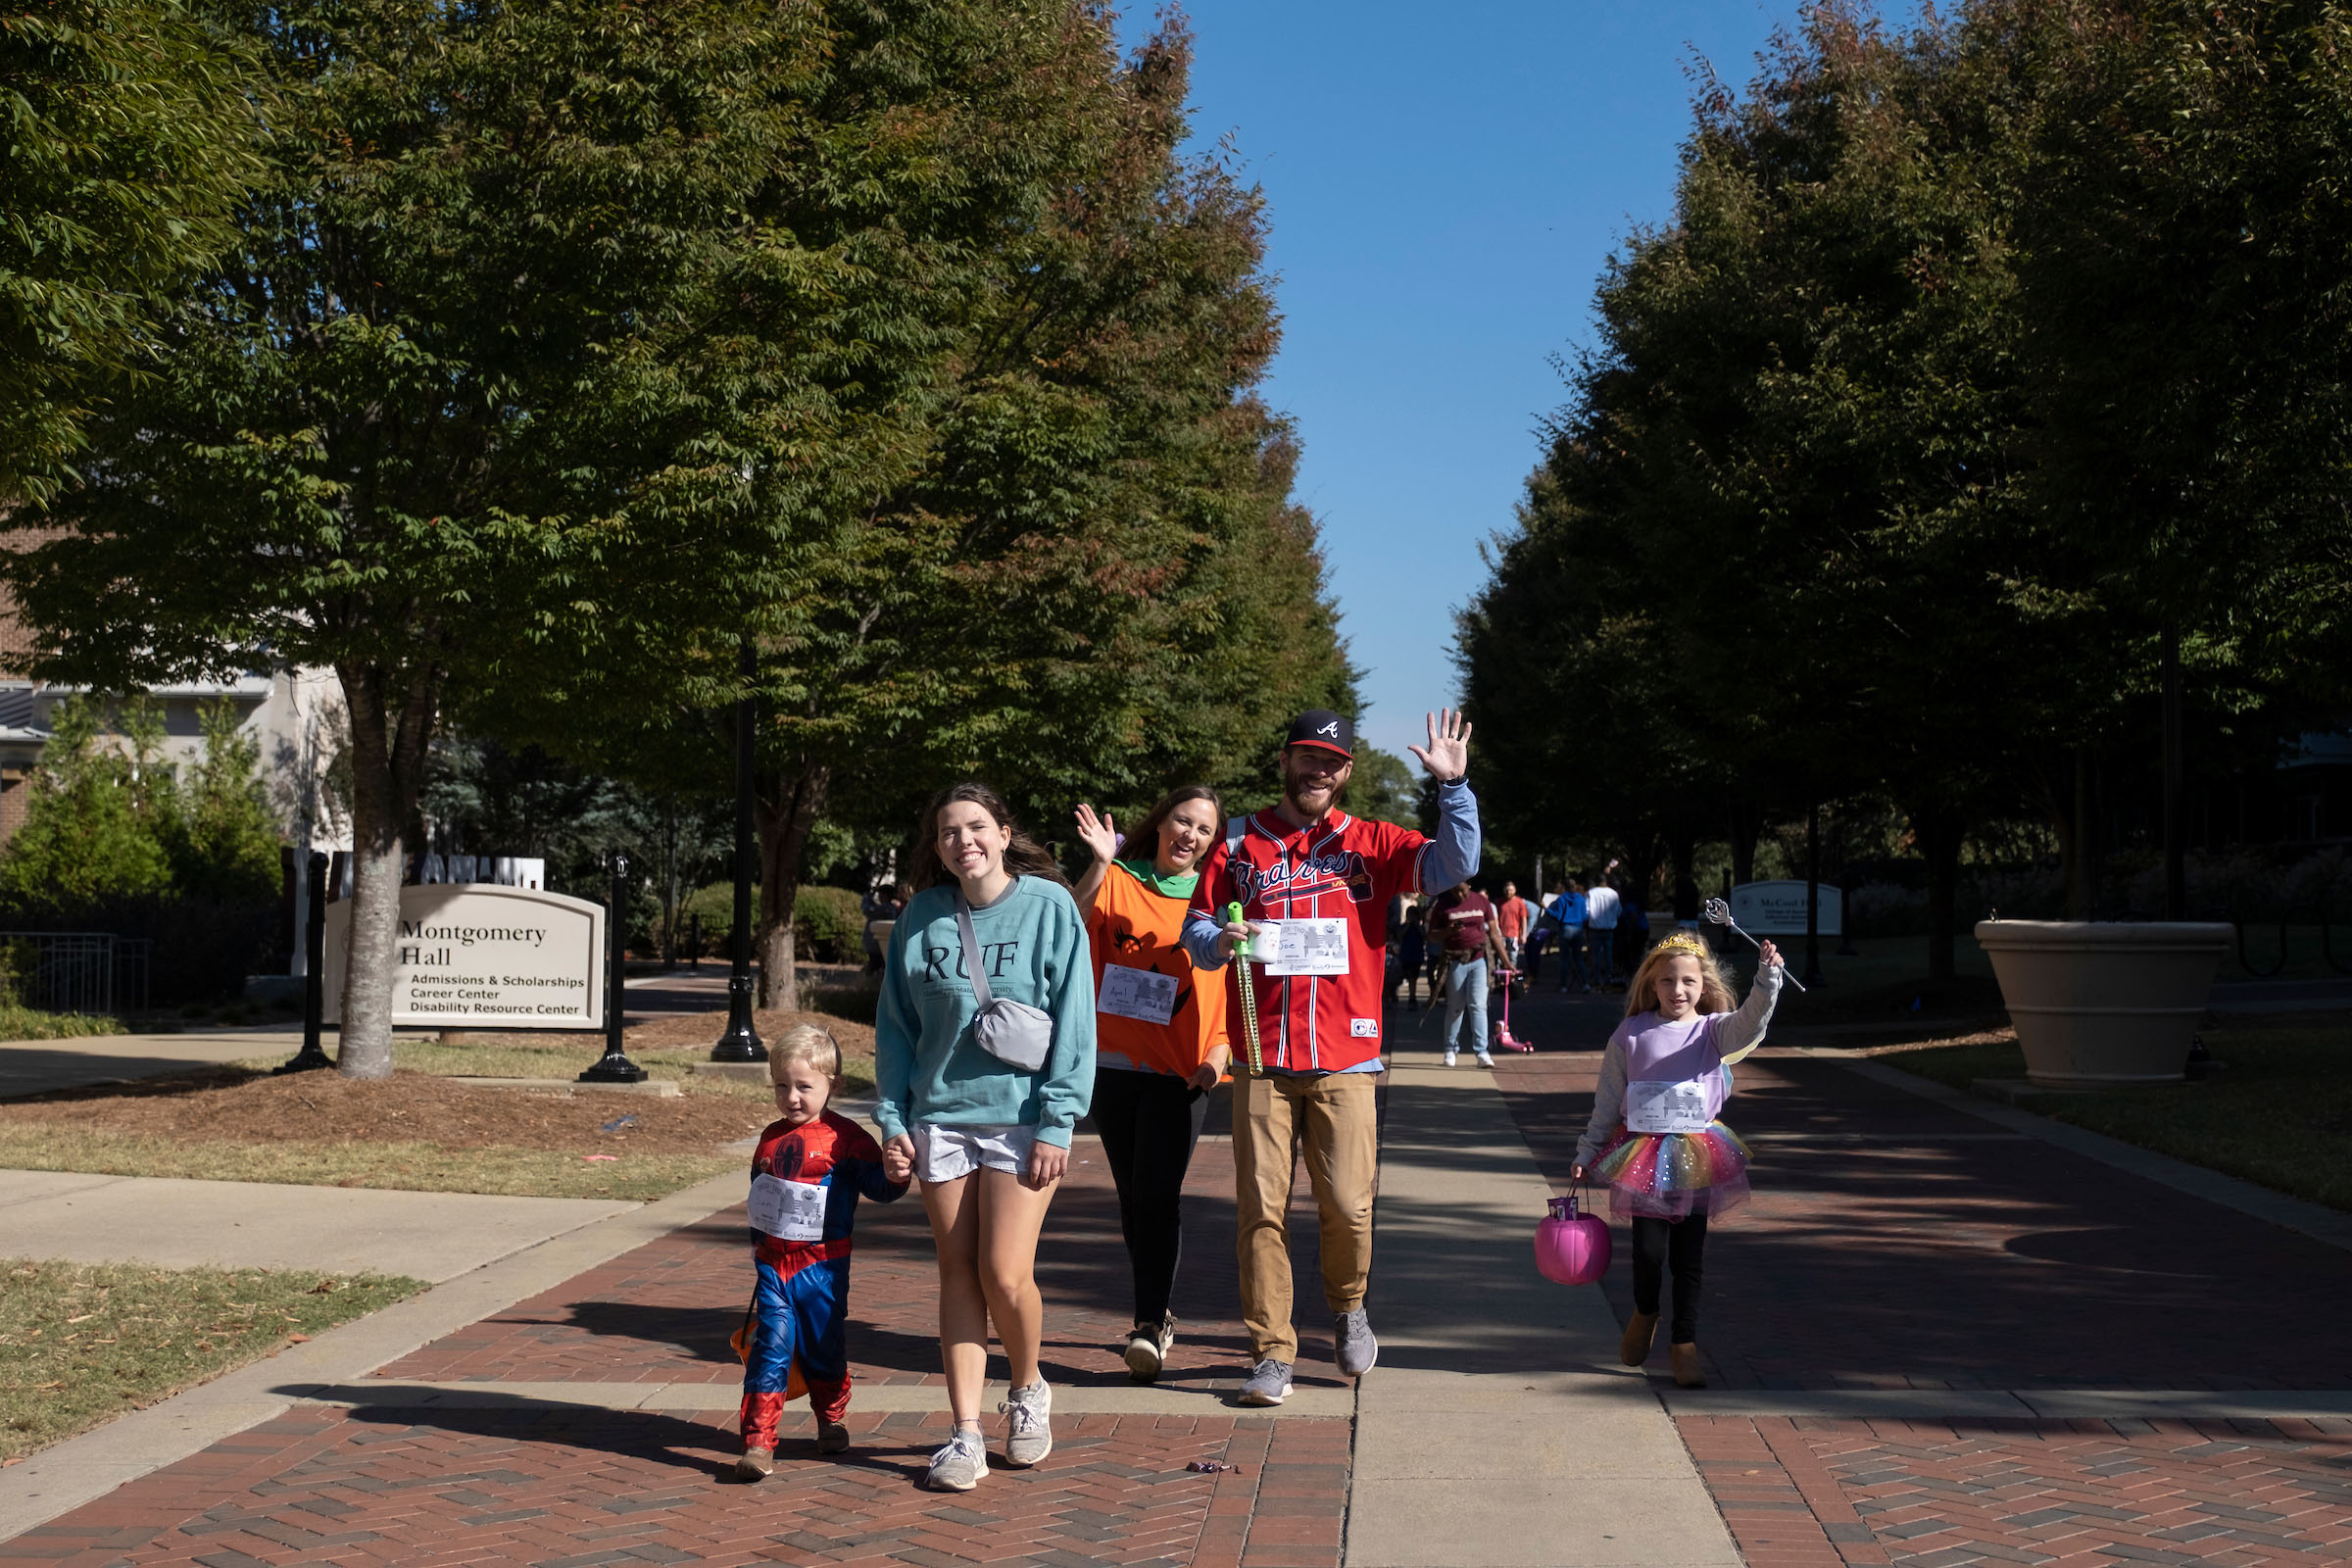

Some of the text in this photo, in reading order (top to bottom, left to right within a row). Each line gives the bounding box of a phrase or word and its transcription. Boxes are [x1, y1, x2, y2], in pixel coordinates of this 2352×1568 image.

[1316, 720, 1339, 739] A
[1234, 849, 1351, 906] Braves
[401, 919, 547, 948] Montgomery
[400, 947, 451, 966] Hall
[923, 941, 1019, 984] RUF
[411, 974, 585, 989] Admissions & Scholarships
[411, 988, 500, 1000] Career Center
[410, 1002, 580, 1014] Disability Resource Center
